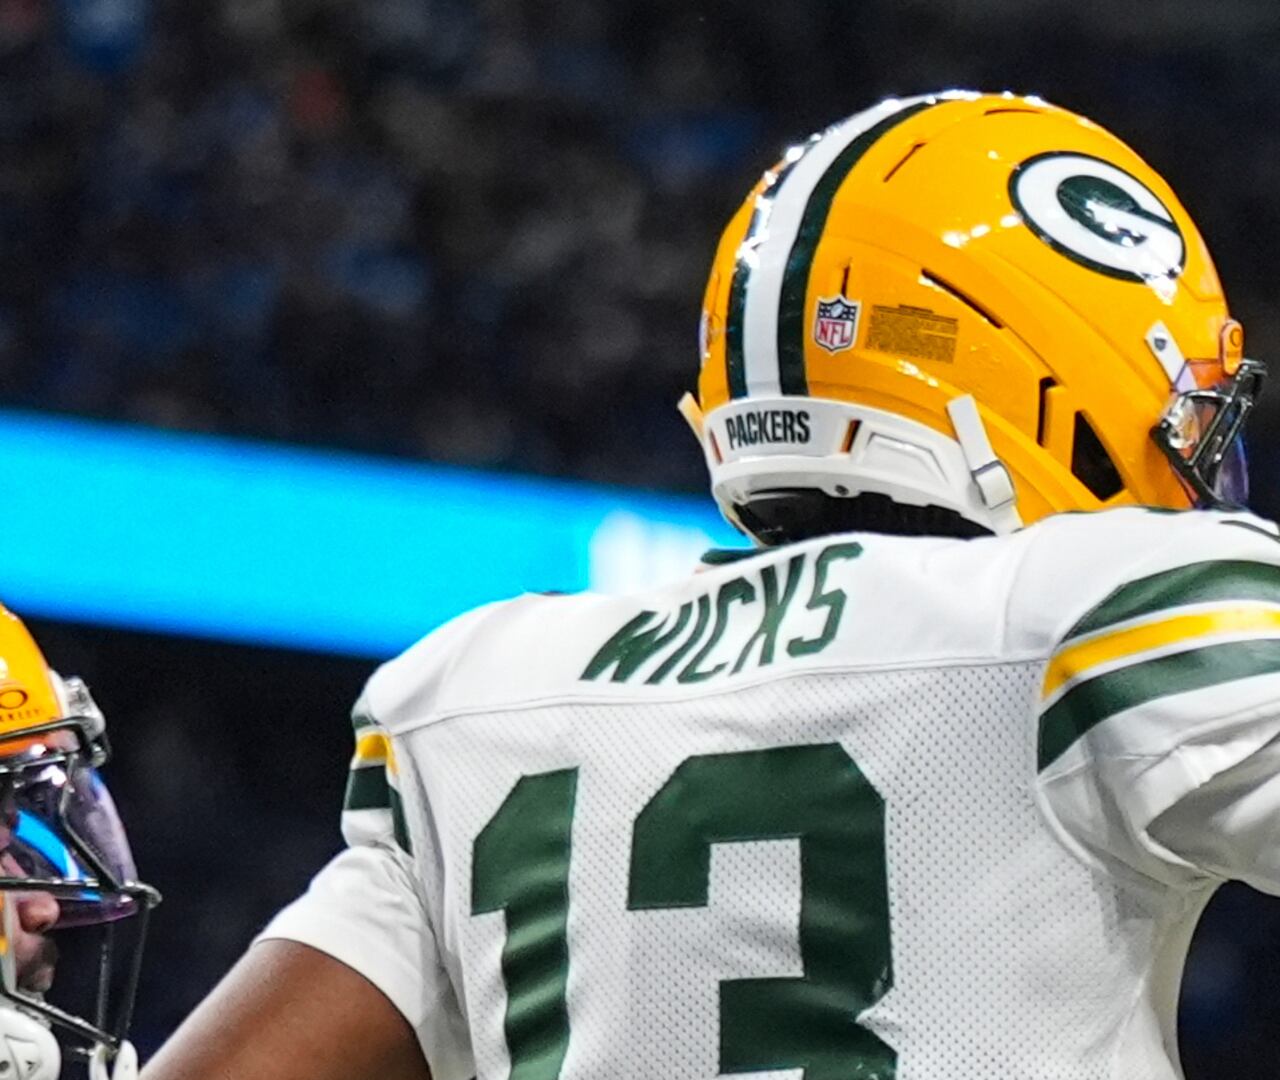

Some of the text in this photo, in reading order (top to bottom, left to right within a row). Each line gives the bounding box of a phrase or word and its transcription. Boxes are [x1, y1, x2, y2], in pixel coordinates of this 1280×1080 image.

[817, 320, 850, 346] NFL
[724, 409, 811, 450] PACKERS
[578, 541, 864, 686] WICKS
